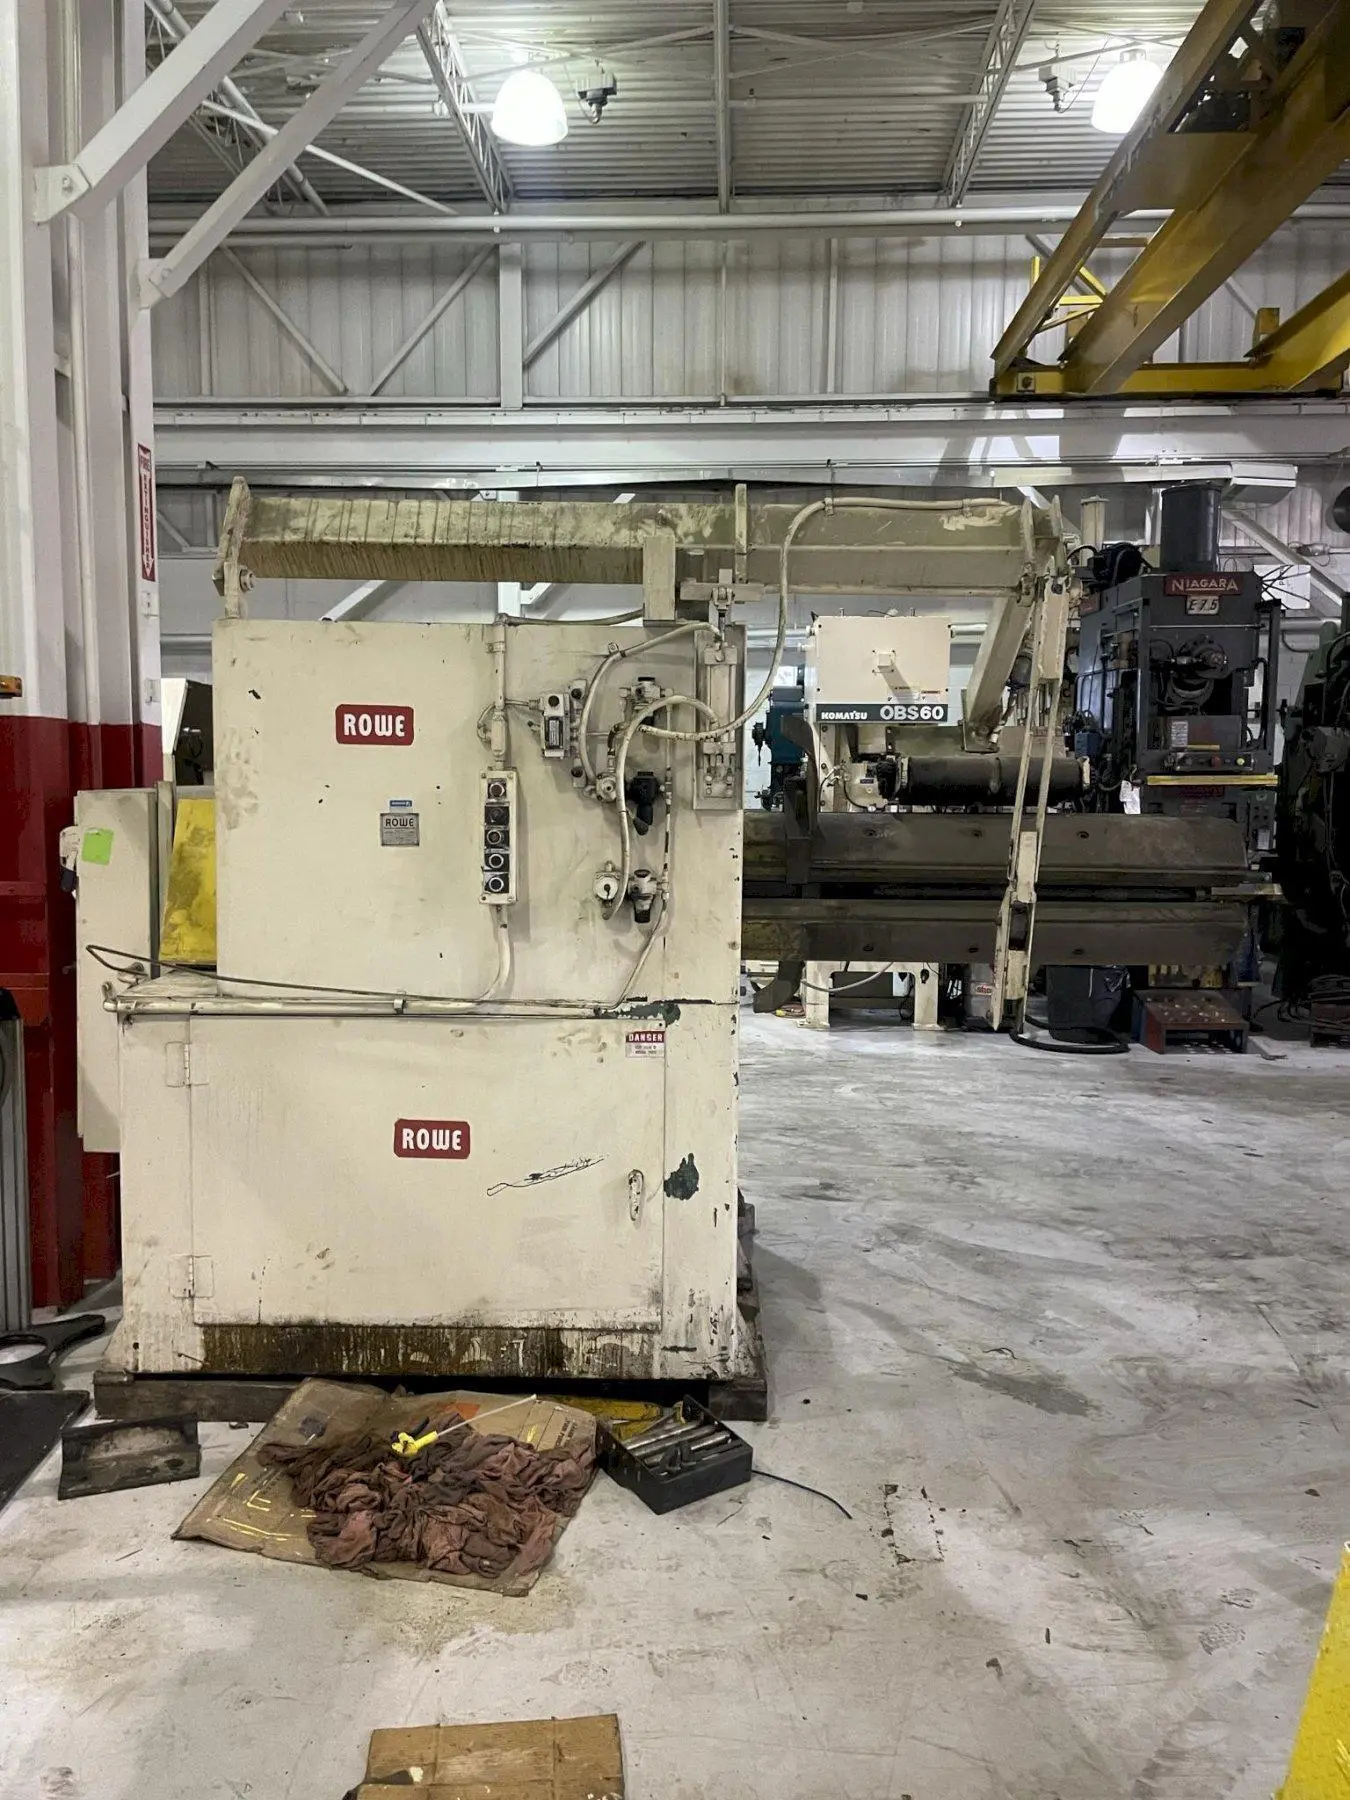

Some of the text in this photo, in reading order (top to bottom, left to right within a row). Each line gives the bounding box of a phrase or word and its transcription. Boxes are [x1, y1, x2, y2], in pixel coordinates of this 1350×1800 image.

[1171, 578, 1239, 592] NIAGARA
[821, 705, 945, 720] KOMATSU OBS60
[343, 713, 406, 737] ROWE
[385, 818, 414, 827] ROWE
[628, 1033, 663, 1042] DANGER
[402, 1128, 462, 1151] ROWE
